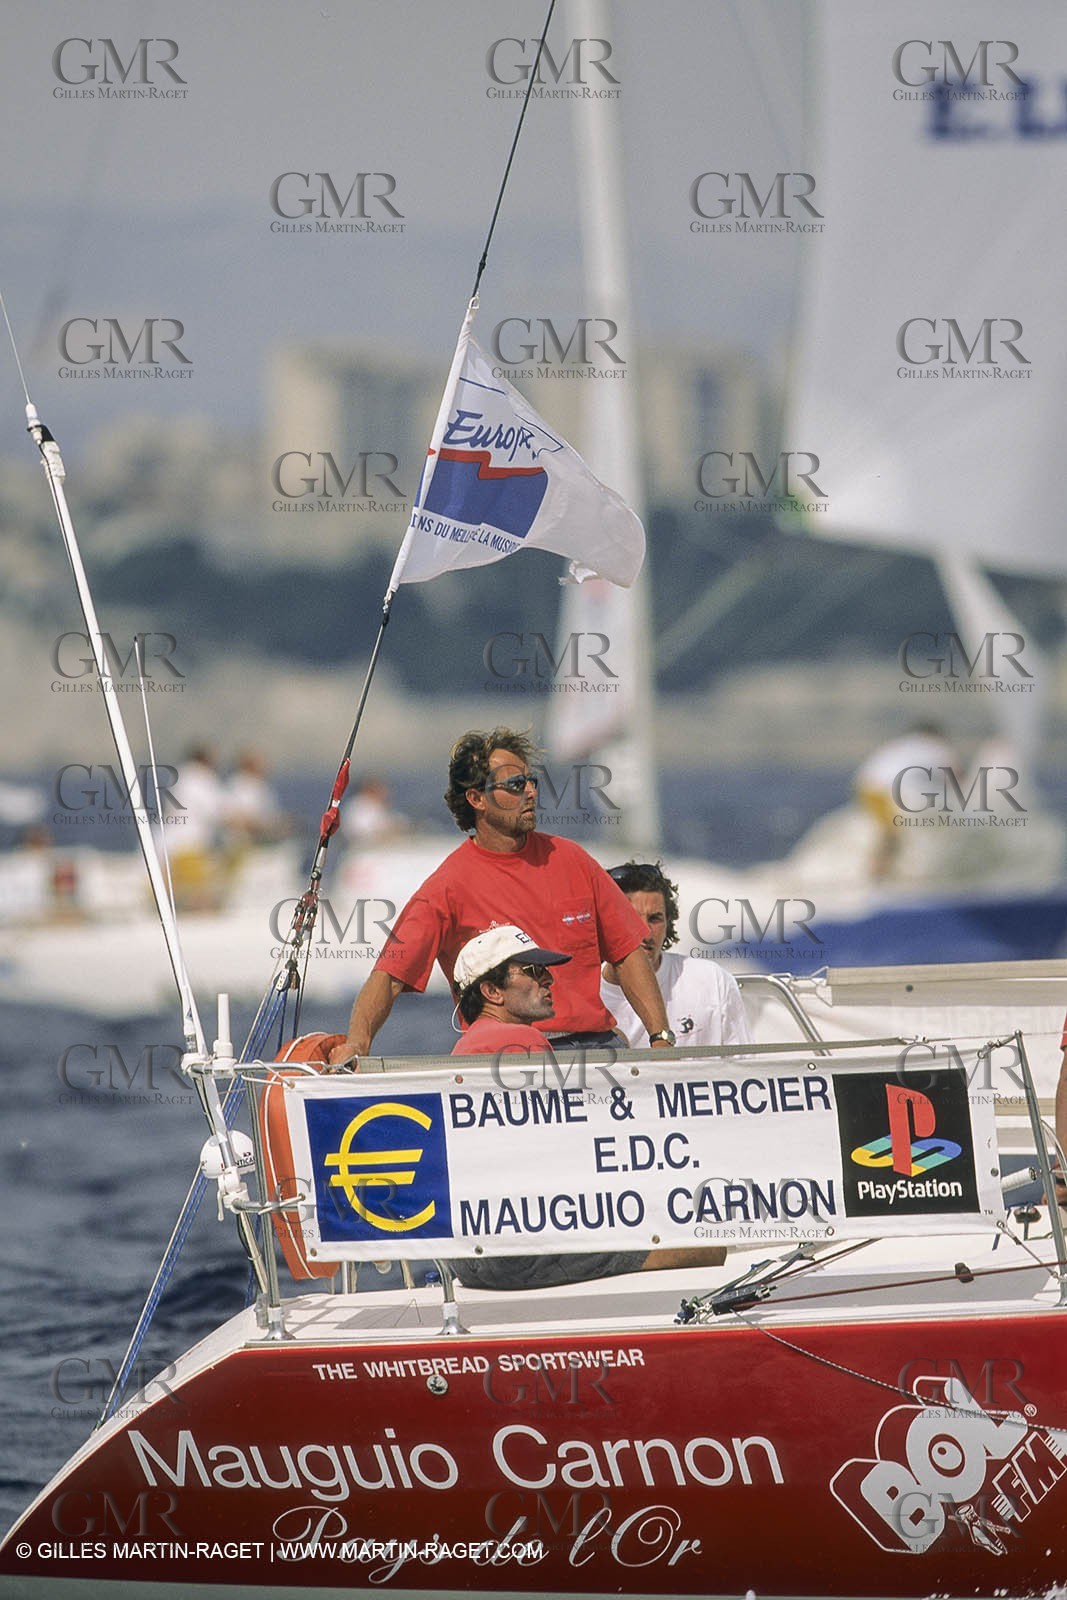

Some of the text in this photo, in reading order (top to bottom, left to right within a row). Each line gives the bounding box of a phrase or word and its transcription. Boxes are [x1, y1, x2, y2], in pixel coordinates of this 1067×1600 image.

[434, 522, 450, 538] DU
[449, 1076, 832, 1128] BAUME & MERCIER
[594, 1132, 700, 1173] E.D.C.
[460, 1179, 836, 1236] MAUGUIO CARNON
[857, 1179, 963, 1204] PlayStation
[313, 1349, 645, 1381] THE WHITBREAD SPORTSWEAR
[127, 1424, 785, 1502] Mauguio Carnon
[992, 1431, 1067, 1523] FM
[272, 1505, 454, 1584] Pays
